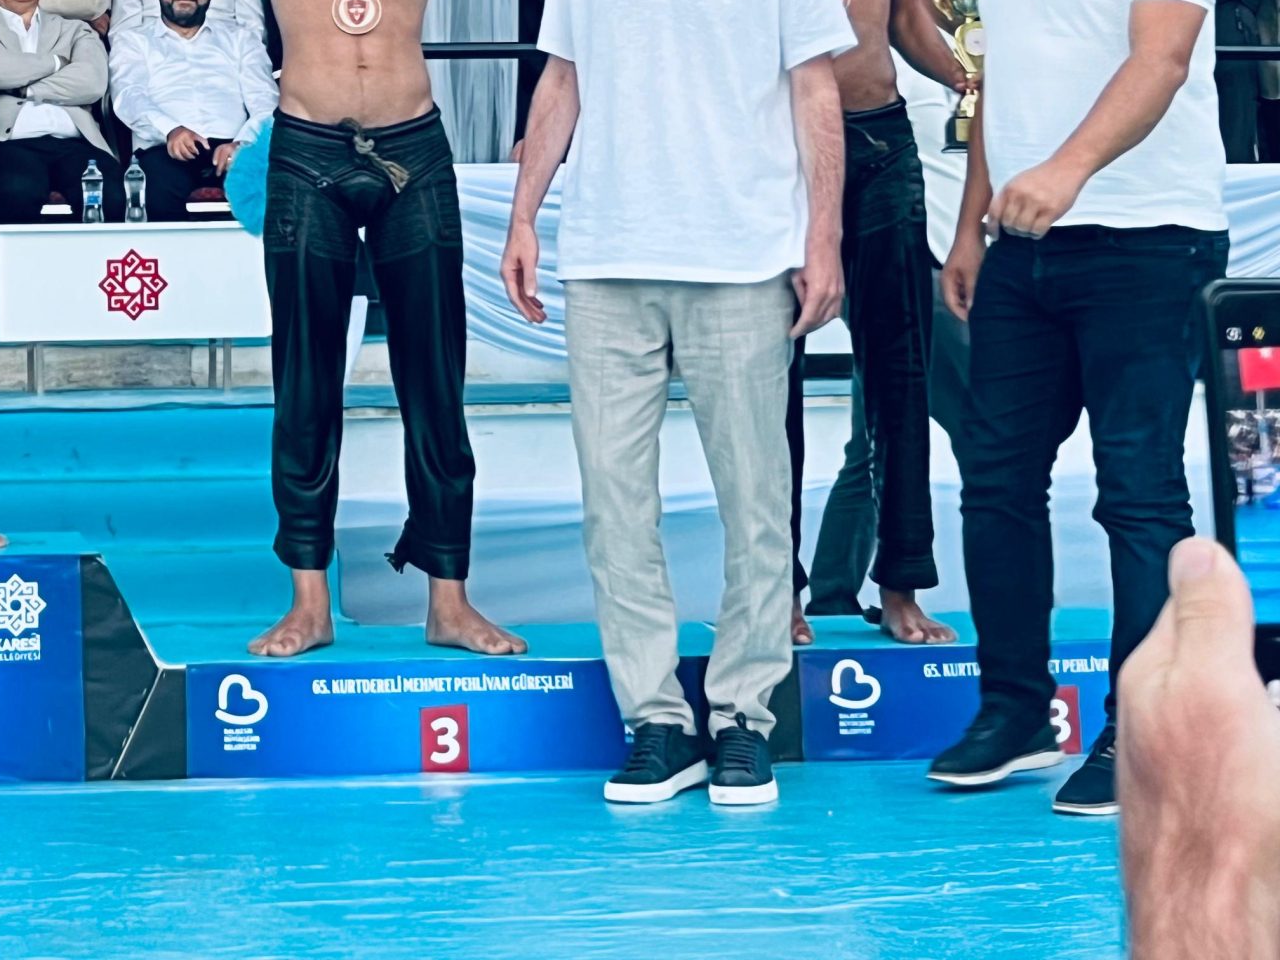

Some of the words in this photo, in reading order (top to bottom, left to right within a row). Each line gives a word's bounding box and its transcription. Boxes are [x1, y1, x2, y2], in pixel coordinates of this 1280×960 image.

[312, 679, 331, 694] 65.
[331, 675, 402, 694] KURTDERELİ
[403, 677, 453, 693] MEHMET
[454, 673, 511, 692] PEHLİVAN
[511, 672, 574, 693] GÜREŞLERİ
[923, 663, 942, 678] 65.
[1049, 698, 1072, 744] 3
[430, 717, 461, 764] 3
